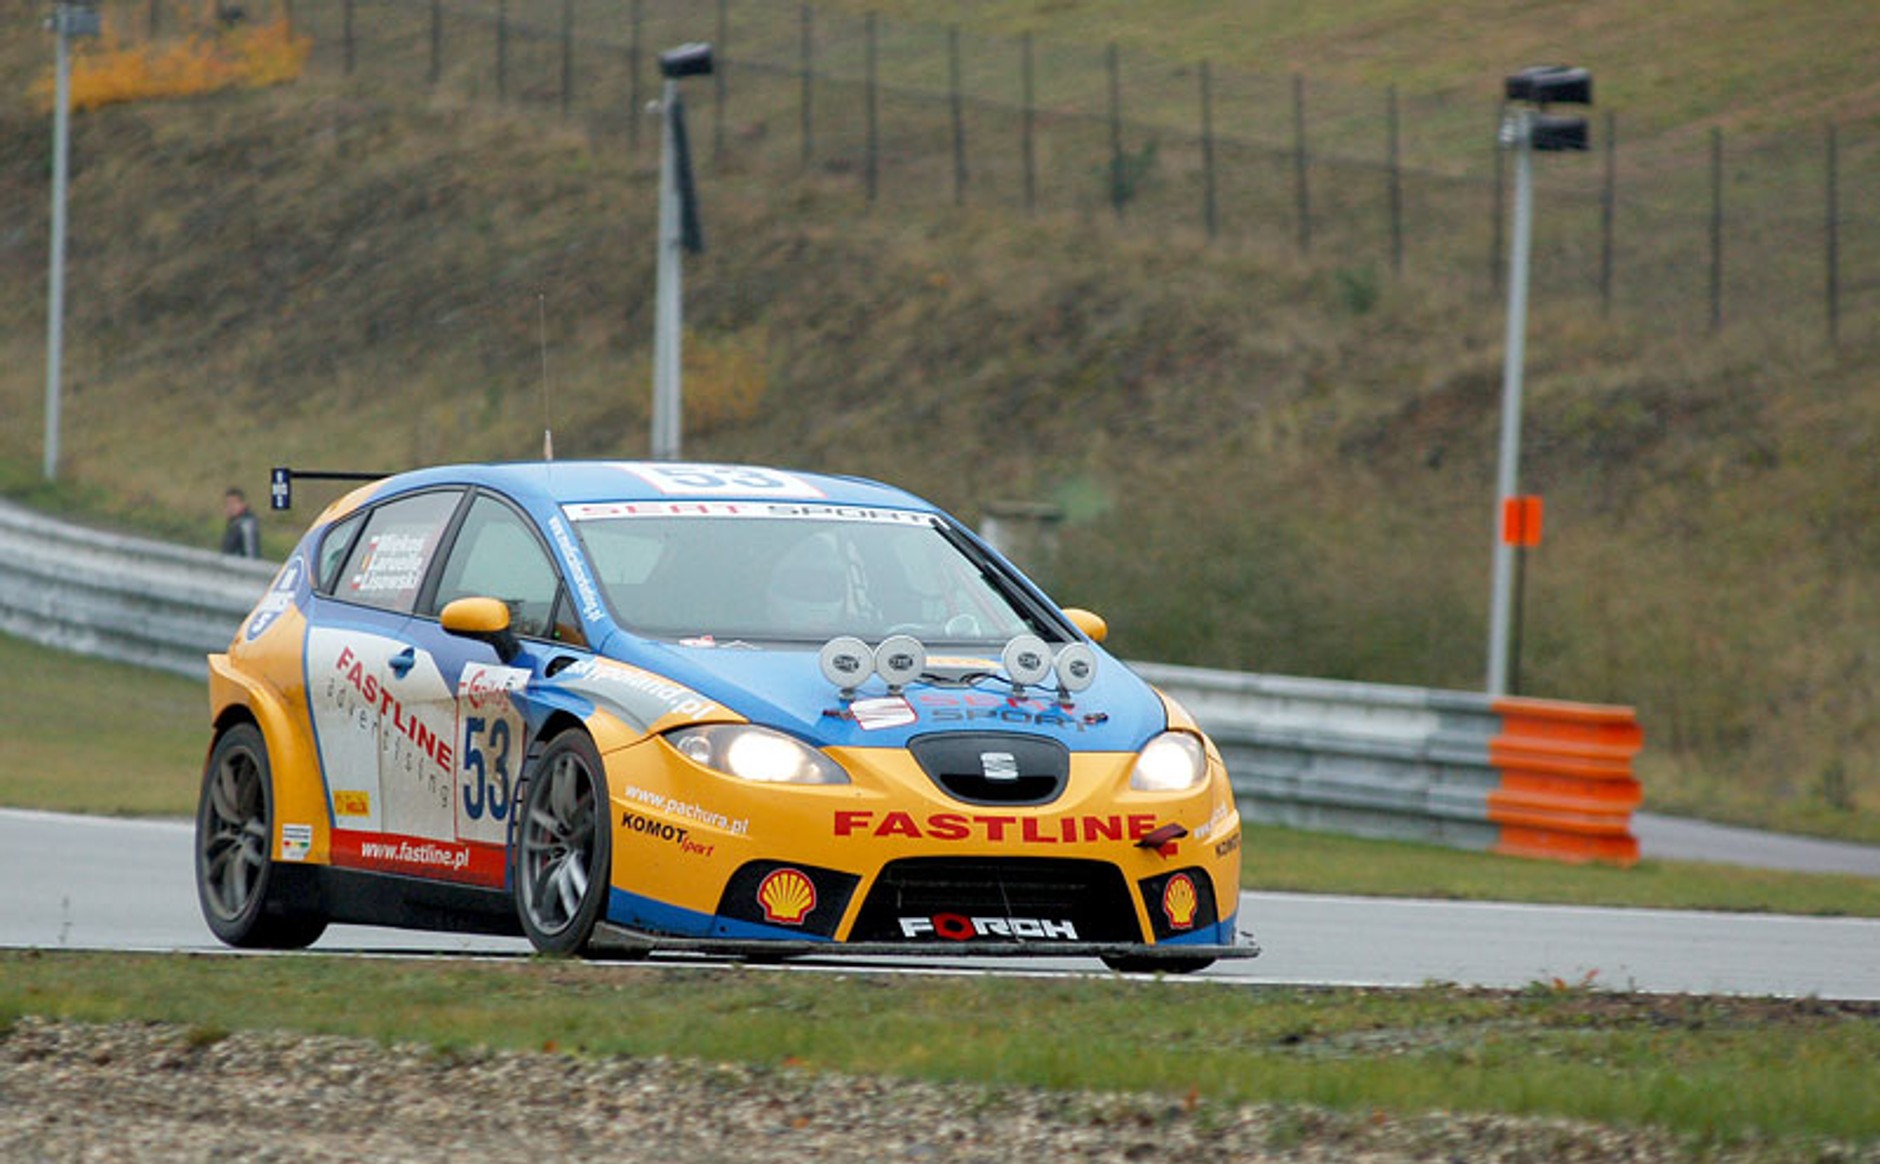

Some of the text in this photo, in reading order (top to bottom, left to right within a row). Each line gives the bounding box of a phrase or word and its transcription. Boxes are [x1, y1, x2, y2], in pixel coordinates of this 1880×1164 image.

[654, 466, 785, 488] 53
[582, 503, 928, 523] SEAT SPORT
[336, 645, 453, 774] FASTLINE
[463, 717, 512, 821] 53
[624, 784, 750, 836] www.pachura.pl
[621, 811, 688, 844] KOMOT
[833, 810, 1156, 844] FASTLINE
[361, 841, 471, 871] www.fastline.pl
